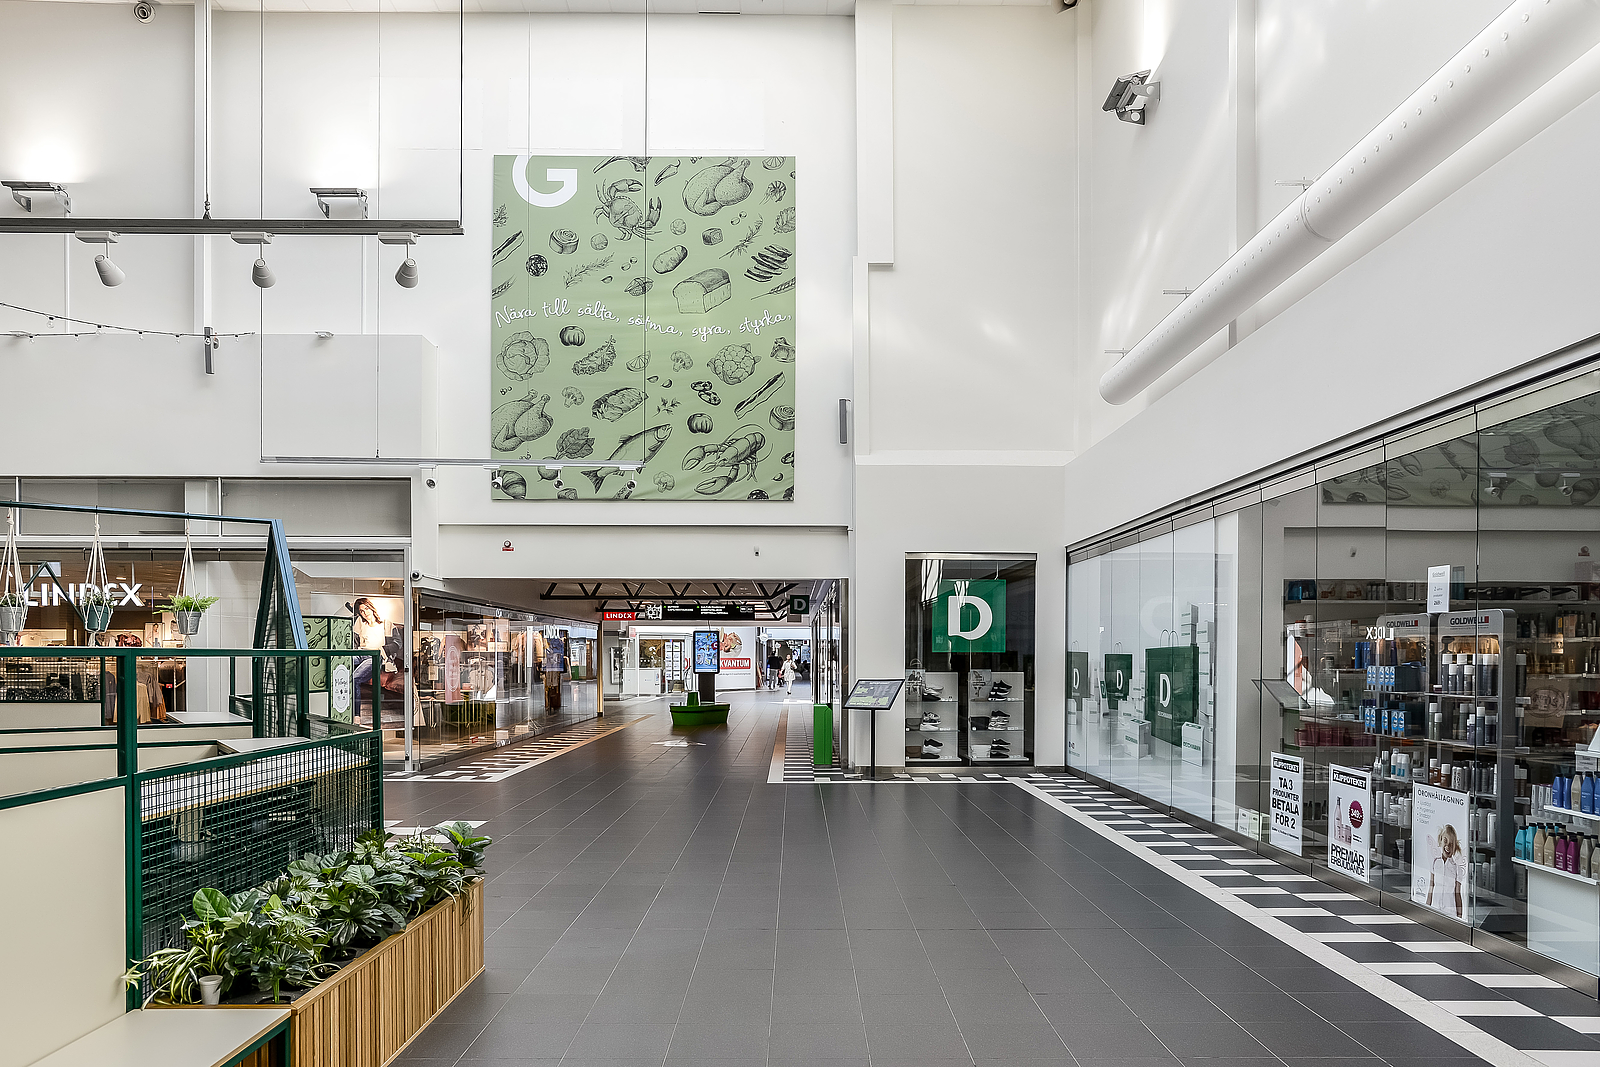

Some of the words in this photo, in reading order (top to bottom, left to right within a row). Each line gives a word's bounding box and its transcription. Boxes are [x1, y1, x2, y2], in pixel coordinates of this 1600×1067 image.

[512, 155, 578, 207] G
[495, 305, 537, 328] Nära
[541, 297, 572, 318] till
[577, 301, 620, 323] sälta,
[627, 313, 684, 338] sötma,
[691, 325, 731, 343] syra,
[738, 309, 793, 336] styrka,
[793, 598, 807, 611] D
[947, 595, 993, 640] D
[1386, 619, 1415, 628] GOLDWELL
[1449, 616, 1485, 626] GOLDWELL
[1159, 673, 1172, 708] D
[1278, 776, 1288, 790] TA
[1288, 779, 1294, 791] 3
[1272, 788, 1300, 802] PRODUKTER
[1417, 788, 1465, 806] ÖRONHÅLTAGNING
[1272, 798, 1300, 817] BETALA
[1275, 812, 1290, 828] FÖR
[1290, 818, 1296, 830] 2
[1331, 843, 1365, 868] PREMIÄR
